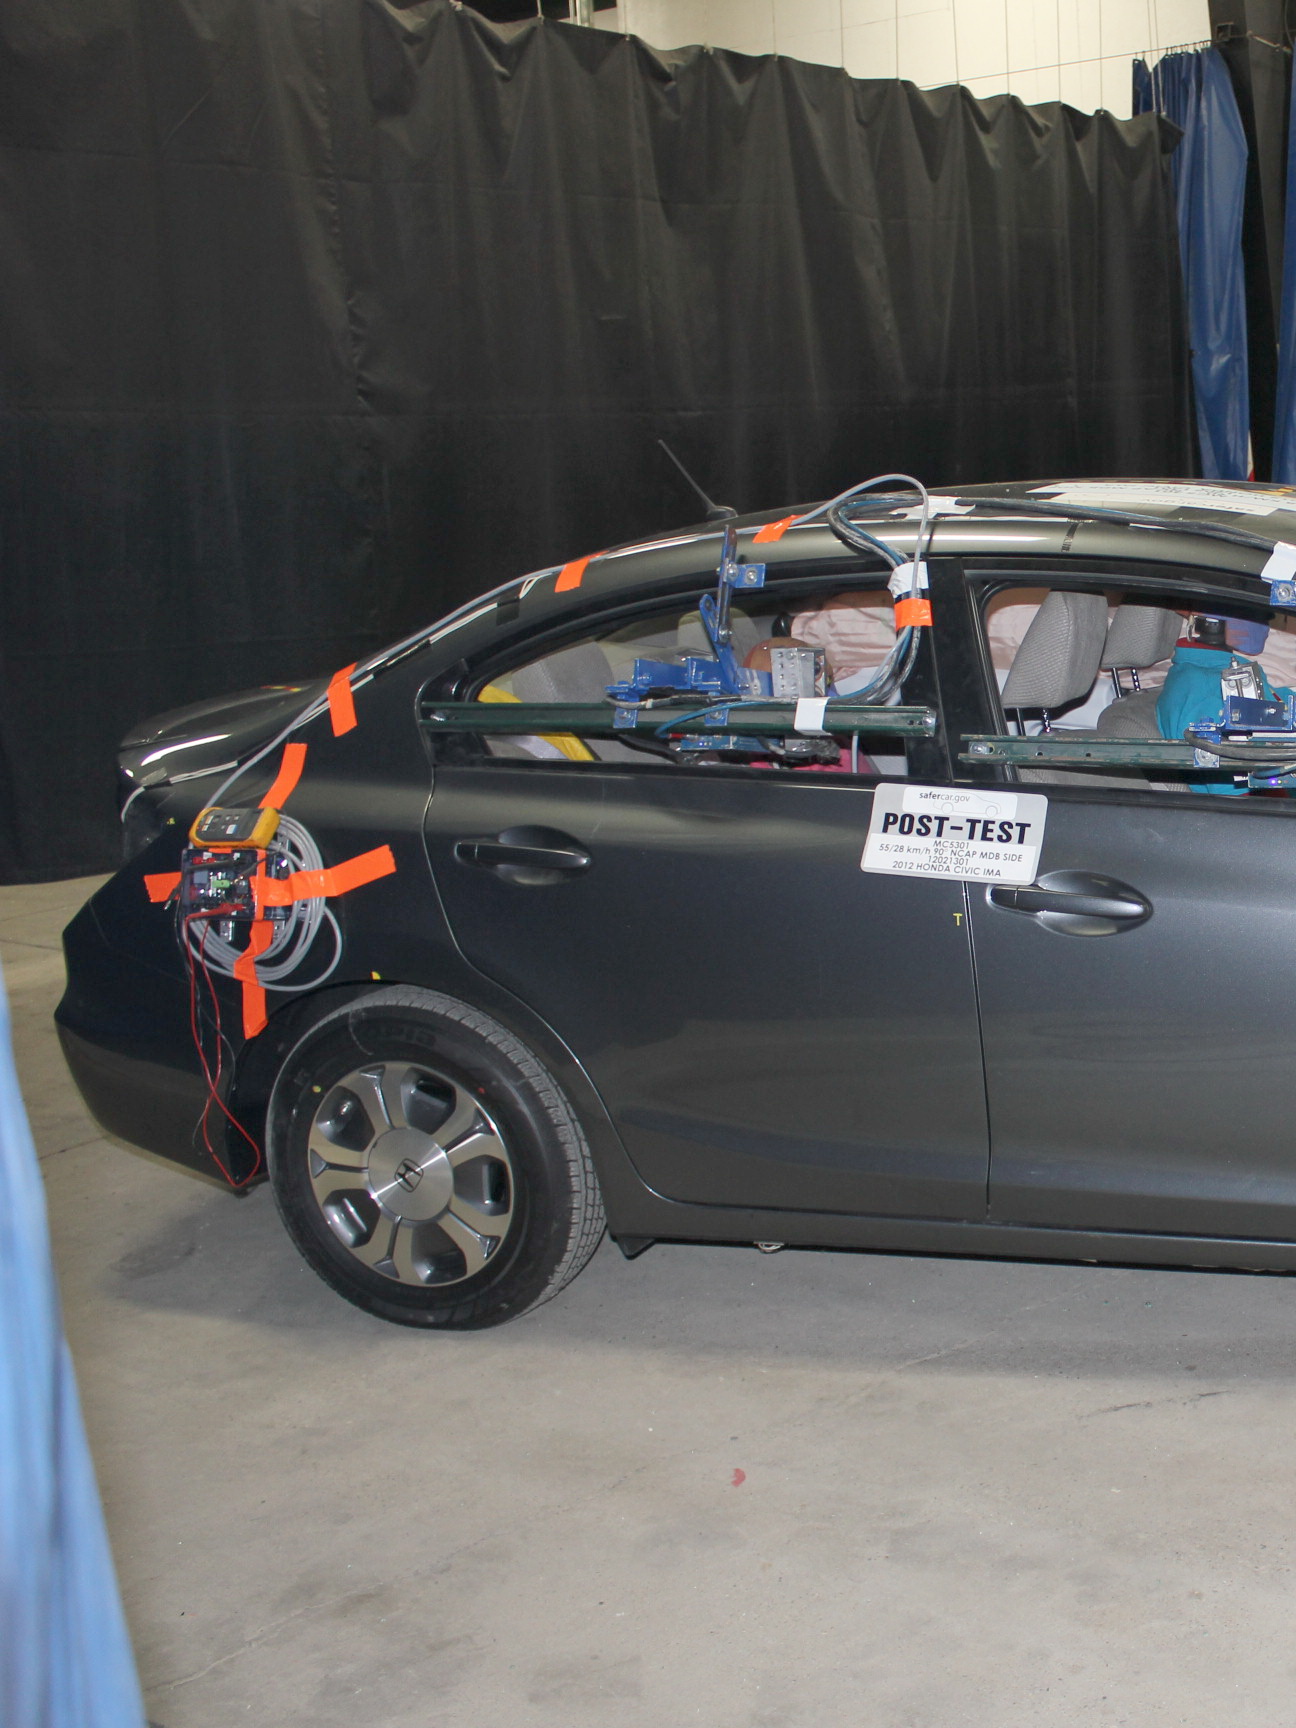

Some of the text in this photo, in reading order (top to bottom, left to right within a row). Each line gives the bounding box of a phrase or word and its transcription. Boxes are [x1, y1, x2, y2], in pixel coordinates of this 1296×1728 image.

[919, 791, 970, 803] safercar.gov
[881, 812, 1031, 844] POST-TEST
[932, 839, 970, 850] MC5301
[879, 843, 904, 853] 55/28
[906, 846, 931, 856] km/h
[950, 849, 977, 859] NCAP
[979, 852, 1000, 861] MDB
[1002, 853, 1023, 862] SIDE
[928, 855, 969, 866] 12021301
[892, 861, 1001, 877] 2012 HONDA CIVIC IMA
